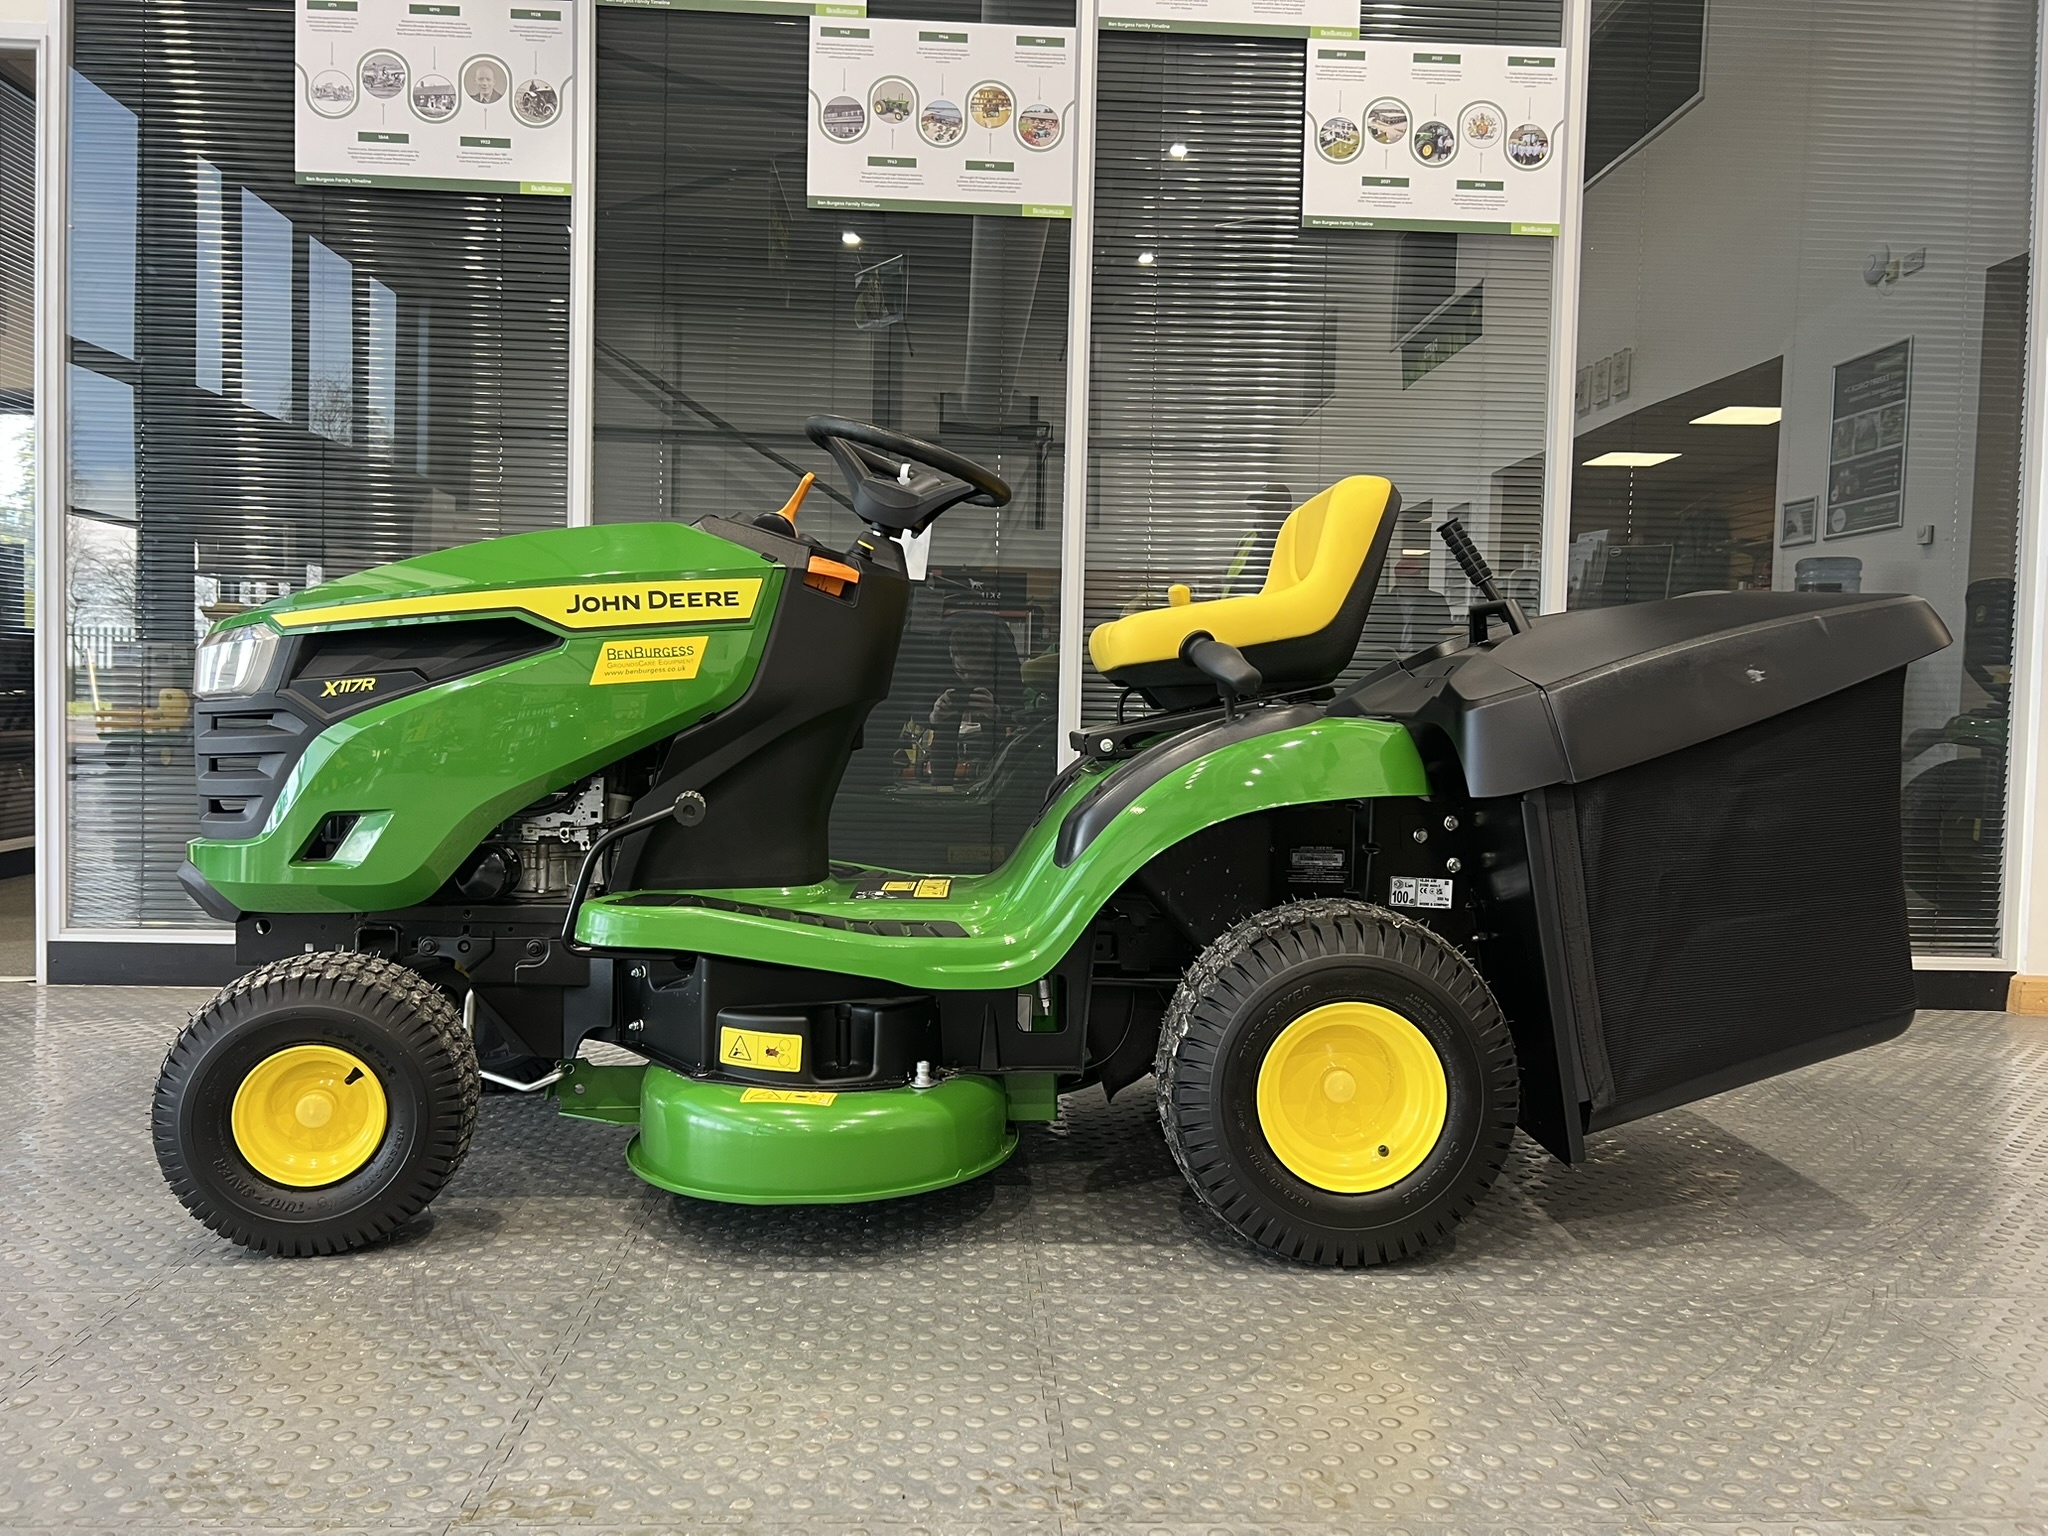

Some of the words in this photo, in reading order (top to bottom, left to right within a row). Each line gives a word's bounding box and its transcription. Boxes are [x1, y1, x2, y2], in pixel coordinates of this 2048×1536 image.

[566, 594, 641, 614] JOHN
[647, 590, 740, 610] DEERE
[320, 677, 376, 698] X117R
[1392, 890, 1408, 903] 100
